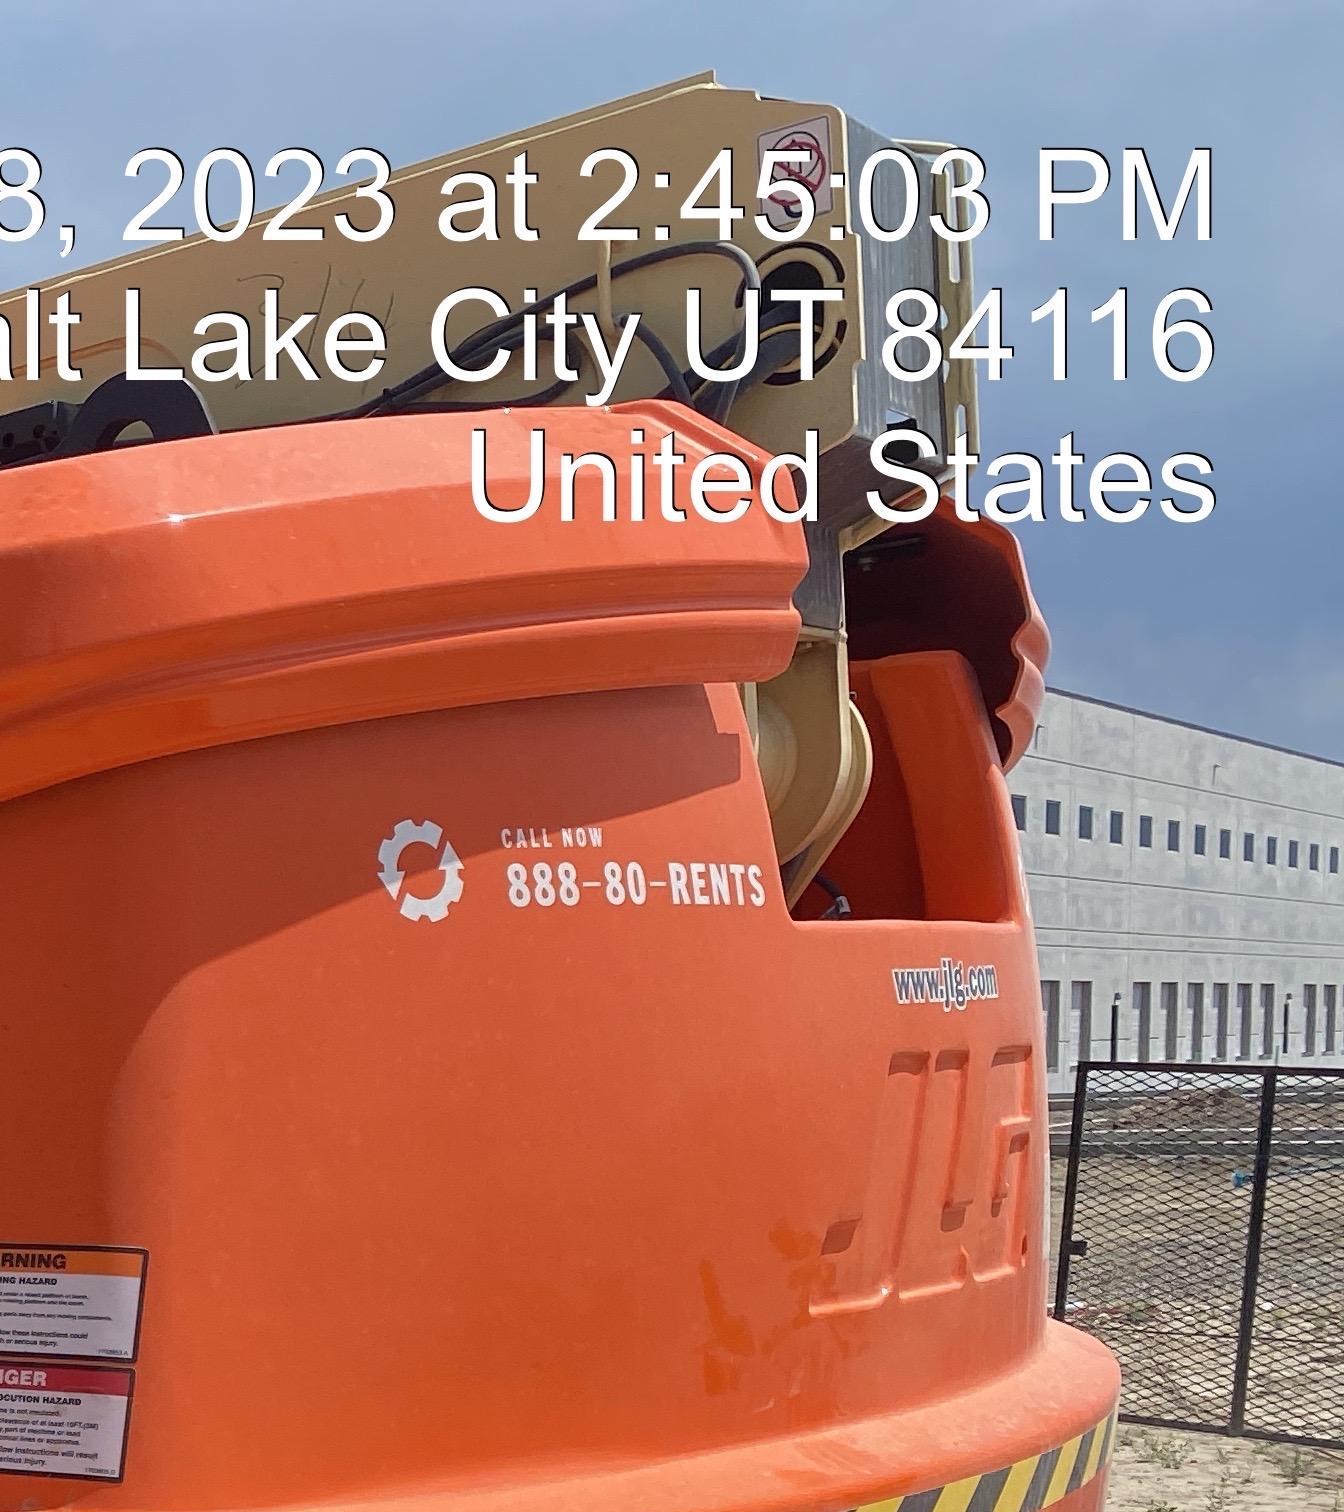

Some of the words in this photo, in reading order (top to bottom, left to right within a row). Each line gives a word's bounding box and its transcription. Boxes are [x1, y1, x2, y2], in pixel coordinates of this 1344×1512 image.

[500, 828, 552, 849] CALL
[561, 827, 603, 848] NOW
[506, 861, 766, 908] 888-80-RENTS
[893, 957, 999, 1011] www.jlg.com
[18, 1276, 58, 1286] HAZARD
[42, 1396, 82, 1406] HAZARD
